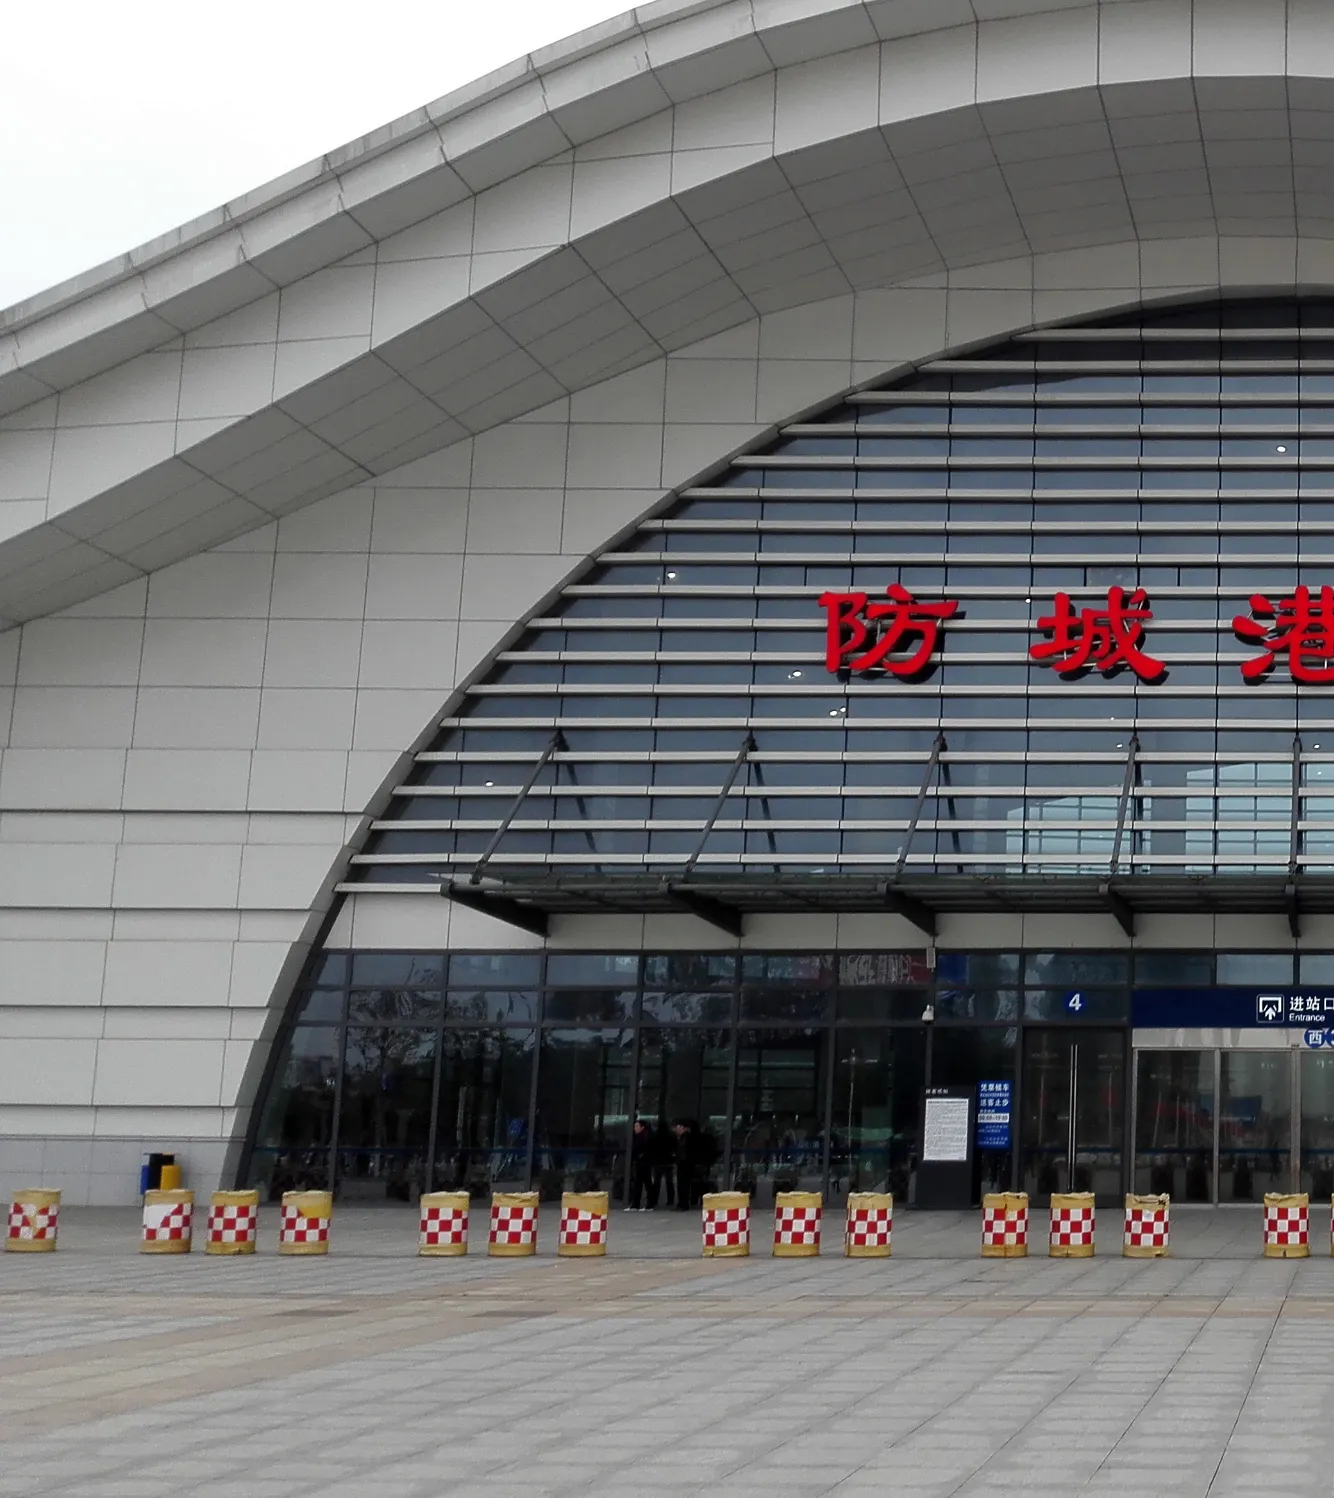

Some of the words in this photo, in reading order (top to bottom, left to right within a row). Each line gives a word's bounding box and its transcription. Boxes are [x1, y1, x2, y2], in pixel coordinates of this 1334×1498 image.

[1069, 994, 1082, 1010] 4
[1289, 1013, 1325, 1021] Entrance
[1308, 1030, 1323, 1045] 西
